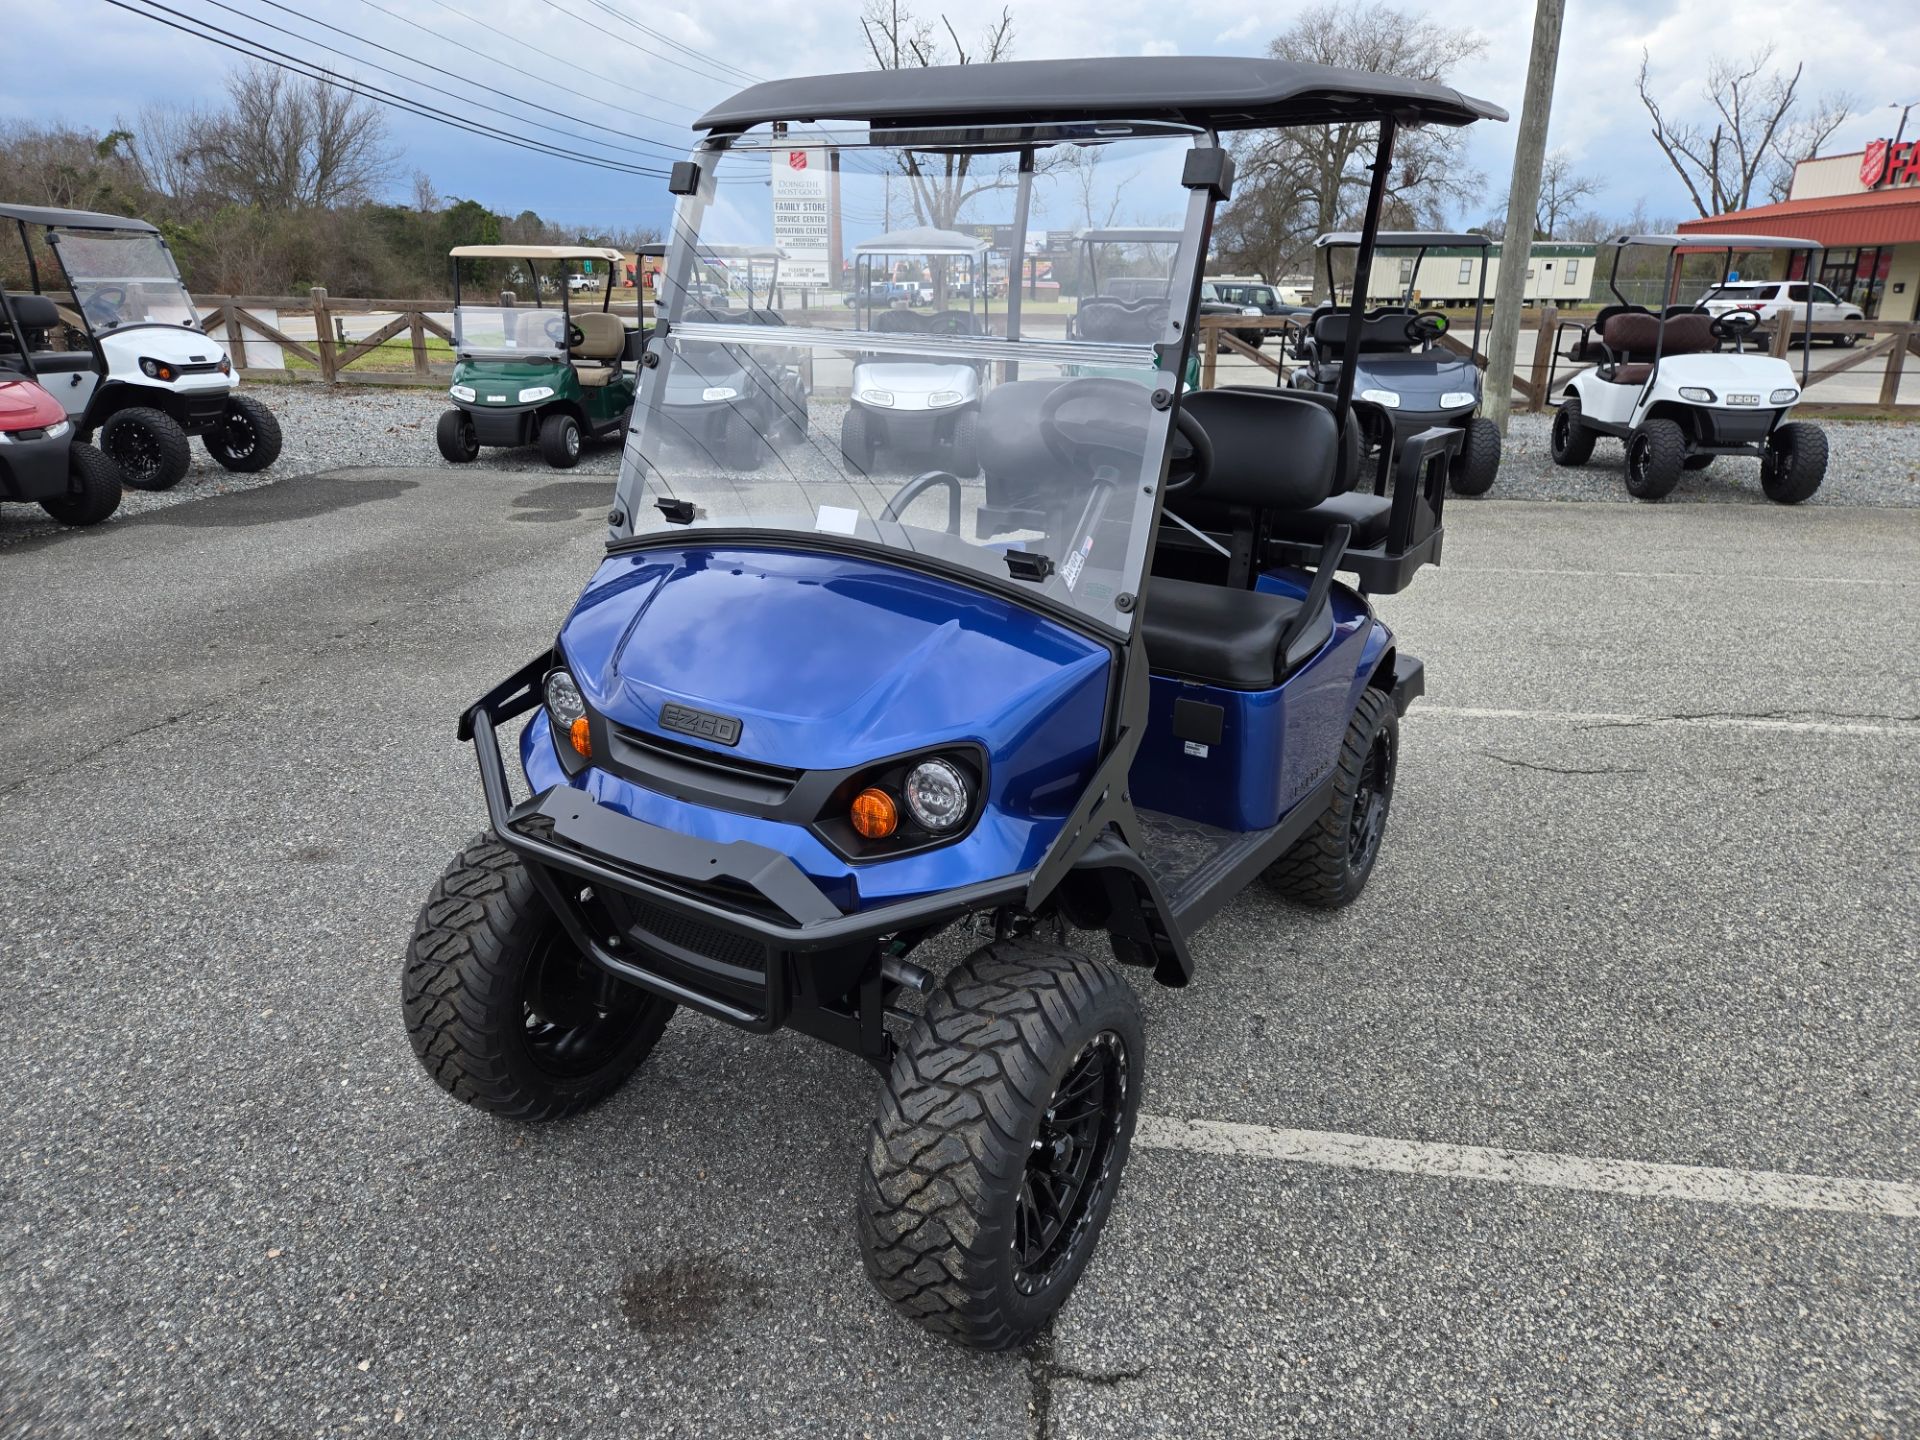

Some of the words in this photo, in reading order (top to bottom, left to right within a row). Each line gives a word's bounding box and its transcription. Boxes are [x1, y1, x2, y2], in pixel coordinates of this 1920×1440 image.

[775, 203, 800, 211] FAMILY
[803, 203, 826, 211] STORE
[776, 215, 801, 223] SERVICE
[802, 215, 826, 223] CENTER
[775, 227, 804, 235] DONATION
[805, 227, 828, 235] CENTER
[663, 709, 735, 740] EZGO
